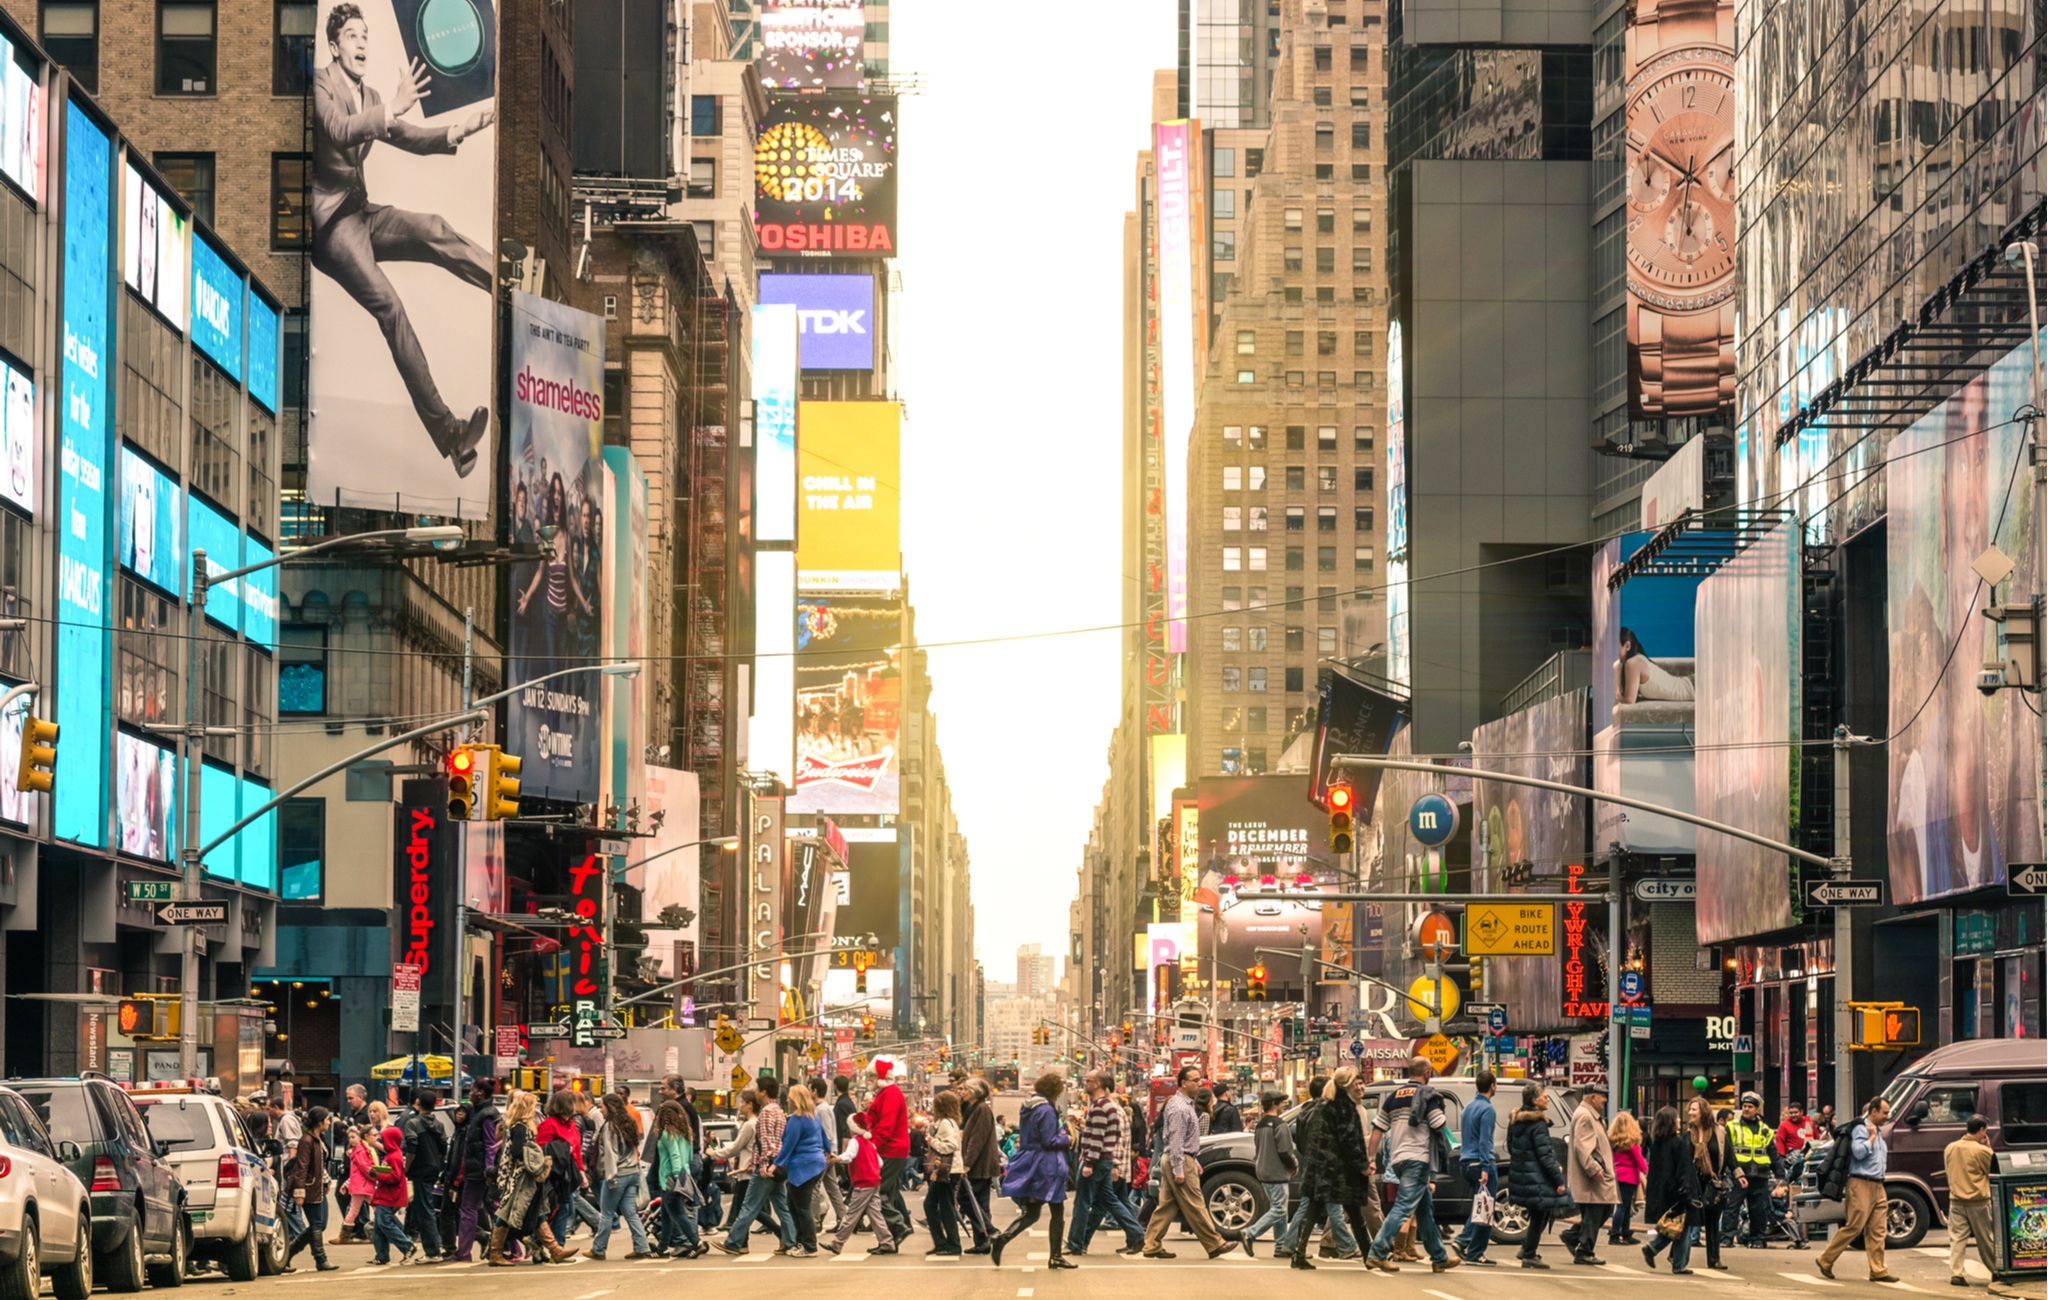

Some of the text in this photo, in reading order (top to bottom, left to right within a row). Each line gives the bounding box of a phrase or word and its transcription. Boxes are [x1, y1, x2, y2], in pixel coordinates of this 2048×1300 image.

[453, 21, 475, 33] ELLIS
[765, 31, 843, 48] SPONSOR
[1681, 85, 1697, 109] 12
[1689, 135, 1708, 143] YORK
[805, 148, 858, 162] TIMES
[816, 163, 884, 180] SQUARE
[755, 223, 893, 250] OSHIBA
[800, 250, 832, 258] TOSHIBA
[202, 279, 230, 340] BARCLAYS
[797, 309, 867, 334] TDK
[529, 323, 541, 338] THIS
[563, 334, 574, 348] TEA
[574, 337, 590, 353] PARTY
[517, 365, 601, 422] shameless
[803, 476, 875, 491] CHILL IN
[806, 495, 872, 510] THE AIR
[64, 555, 101, 616] BARCLAYS
[797, 576, 842, 584] DUNKIN'
[523, 687, 590, 716] JAN 12 SUNDAYS 9PM
[538, 724, 573, 759] SHOWTIME
[1418, 811, 1438, 829] m
[1228, 829, 1308, 842] DECEMBER
[1239, 843, 1308, 855] REMEMBER
[1283, 855, 1308, 863] EVENT
[132, 883, 140, 898] W
[144, 883, 156, 898] 50
[757, 815, 772, 979] PALACE
[1647, 883, 1696, 896] city o
[1820, 888, 1872, 898] ONE WAY
[167, 908, 218, 918] ONE WAY
[1519, 909, 1543, 918] BIKE
[1514, 925, 1548, 934] ROUTE
[1563, 865, 1587, 1002] PLYWRIGHT
[831, 936, 863, 946] ONY
[1513, 940, 1550, 949] AHEAD
[1354, 980, 1410, 1040] R
[1706, 1016, 1736, 1039] RO
[89, 1014, 99, 1068] Newsstand
[1340, 1048, 1408, 1059] RAISSAN
[154, 1061, 200, 1070] PANDA
[1572, 1074, 1608, 1085] PIZZA
